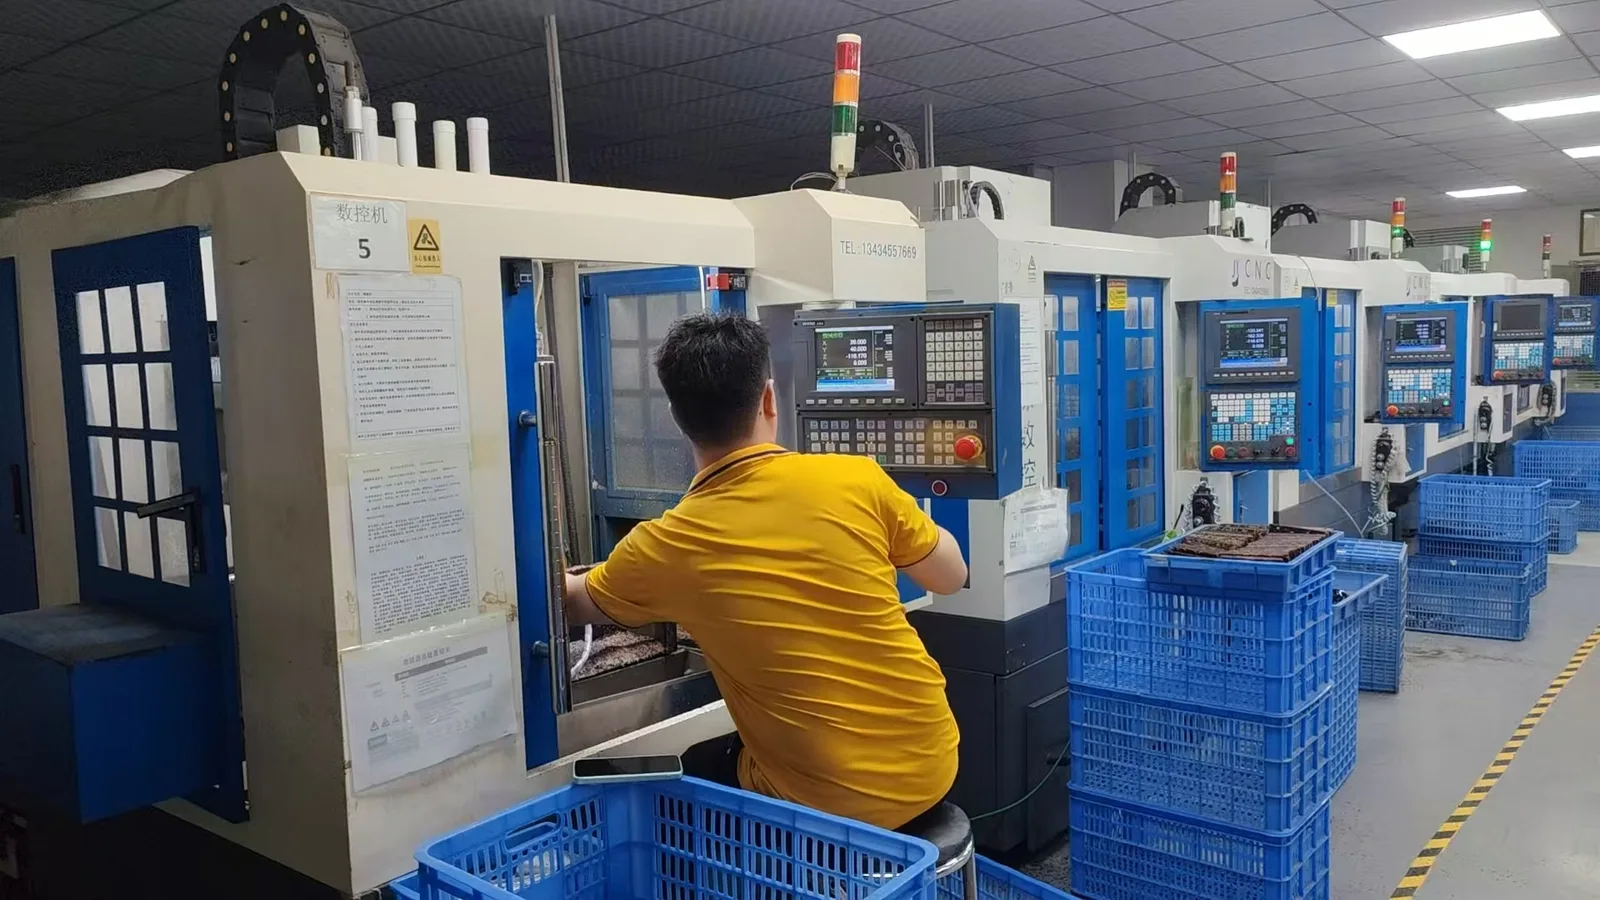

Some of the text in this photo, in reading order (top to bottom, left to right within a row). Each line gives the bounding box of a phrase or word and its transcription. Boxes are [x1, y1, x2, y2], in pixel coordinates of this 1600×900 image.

[336, 203, 387, 224] 数控机
[358, 238, 371, 259] 5
